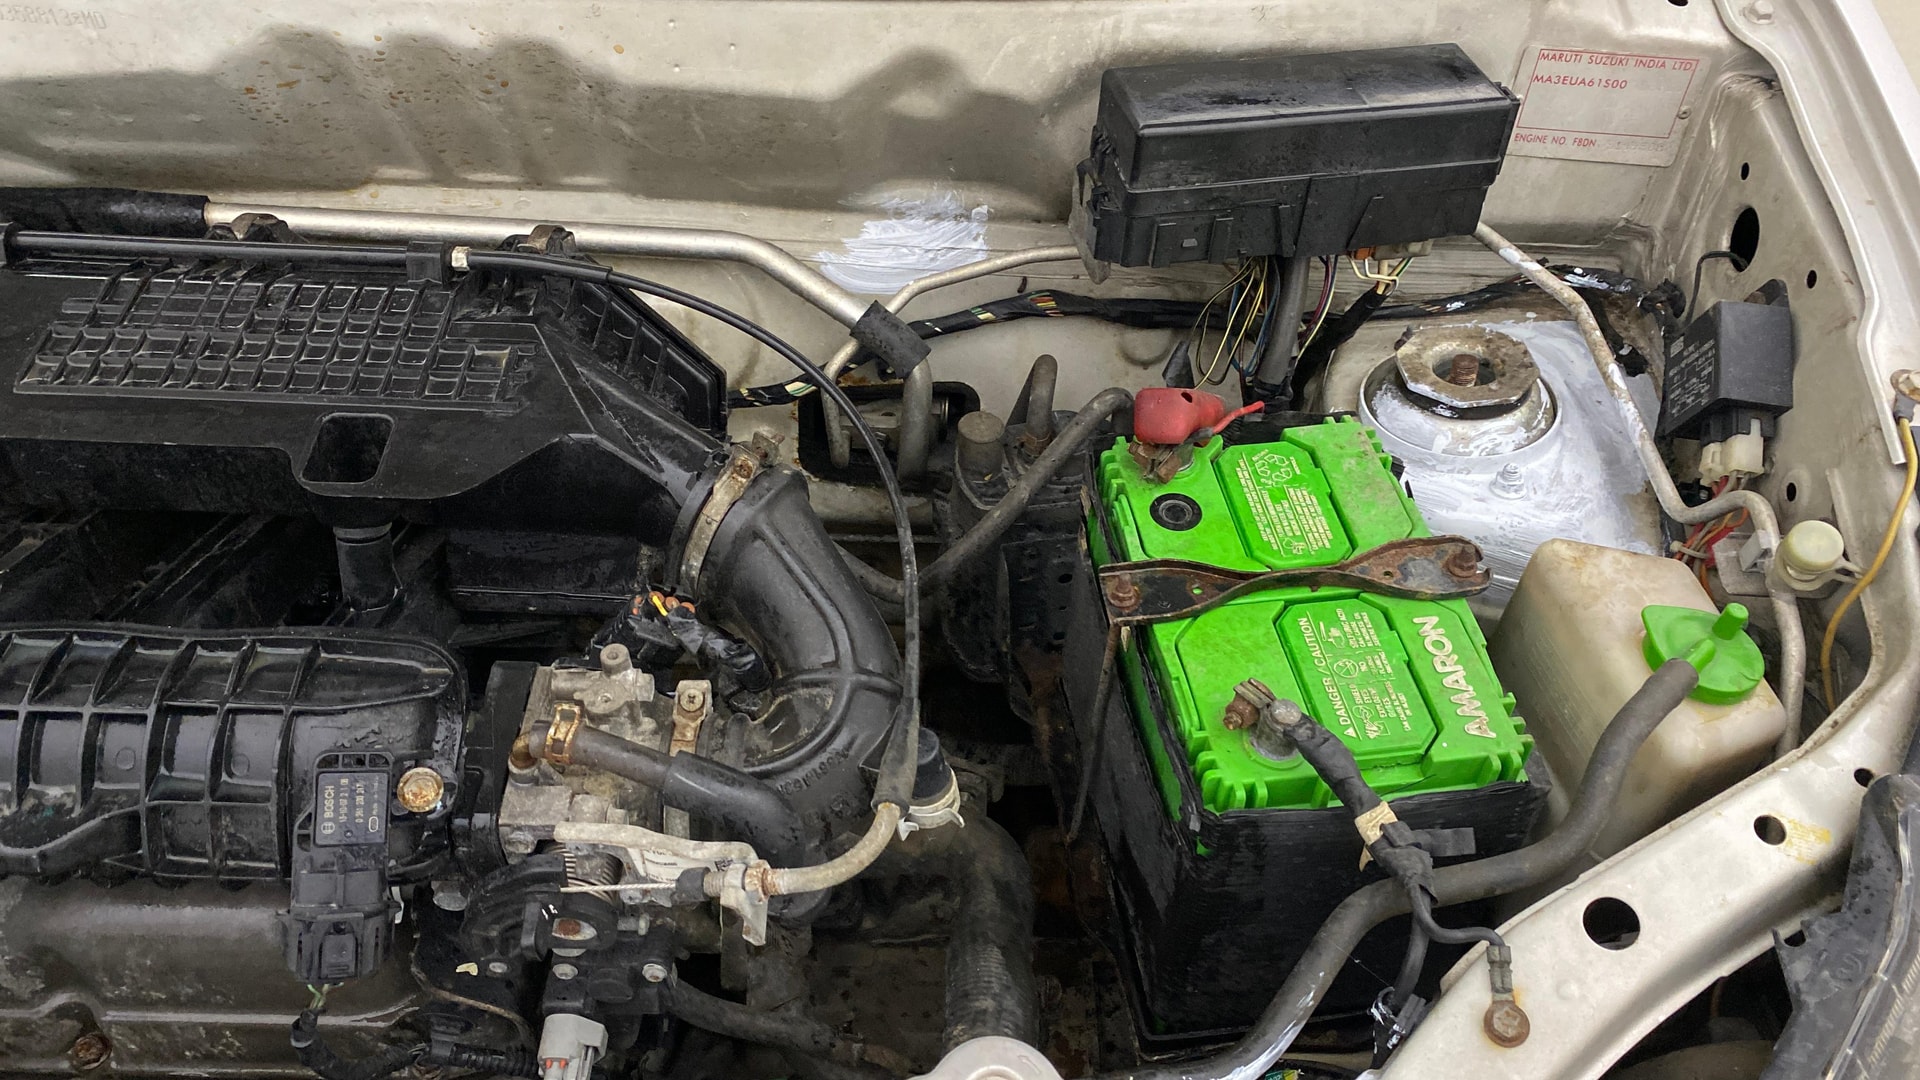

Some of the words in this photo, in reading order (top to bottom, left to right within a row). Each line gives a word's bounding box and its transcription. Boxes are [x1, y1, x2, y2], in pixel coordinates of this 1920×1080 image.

[1539, 52, 1582, 64] MARUTI
[1587, 54, 1629, 67] SUZUKI
[1634, 57, 1667, 69] INDIA
[1532, 74, 1628, 90] MA3EUA61S00
[1514, 133, 1548, 145] ENGINE
[1412, 616, 1497, 739] AMARON
[324, 785, 335, 818] BOSCH
